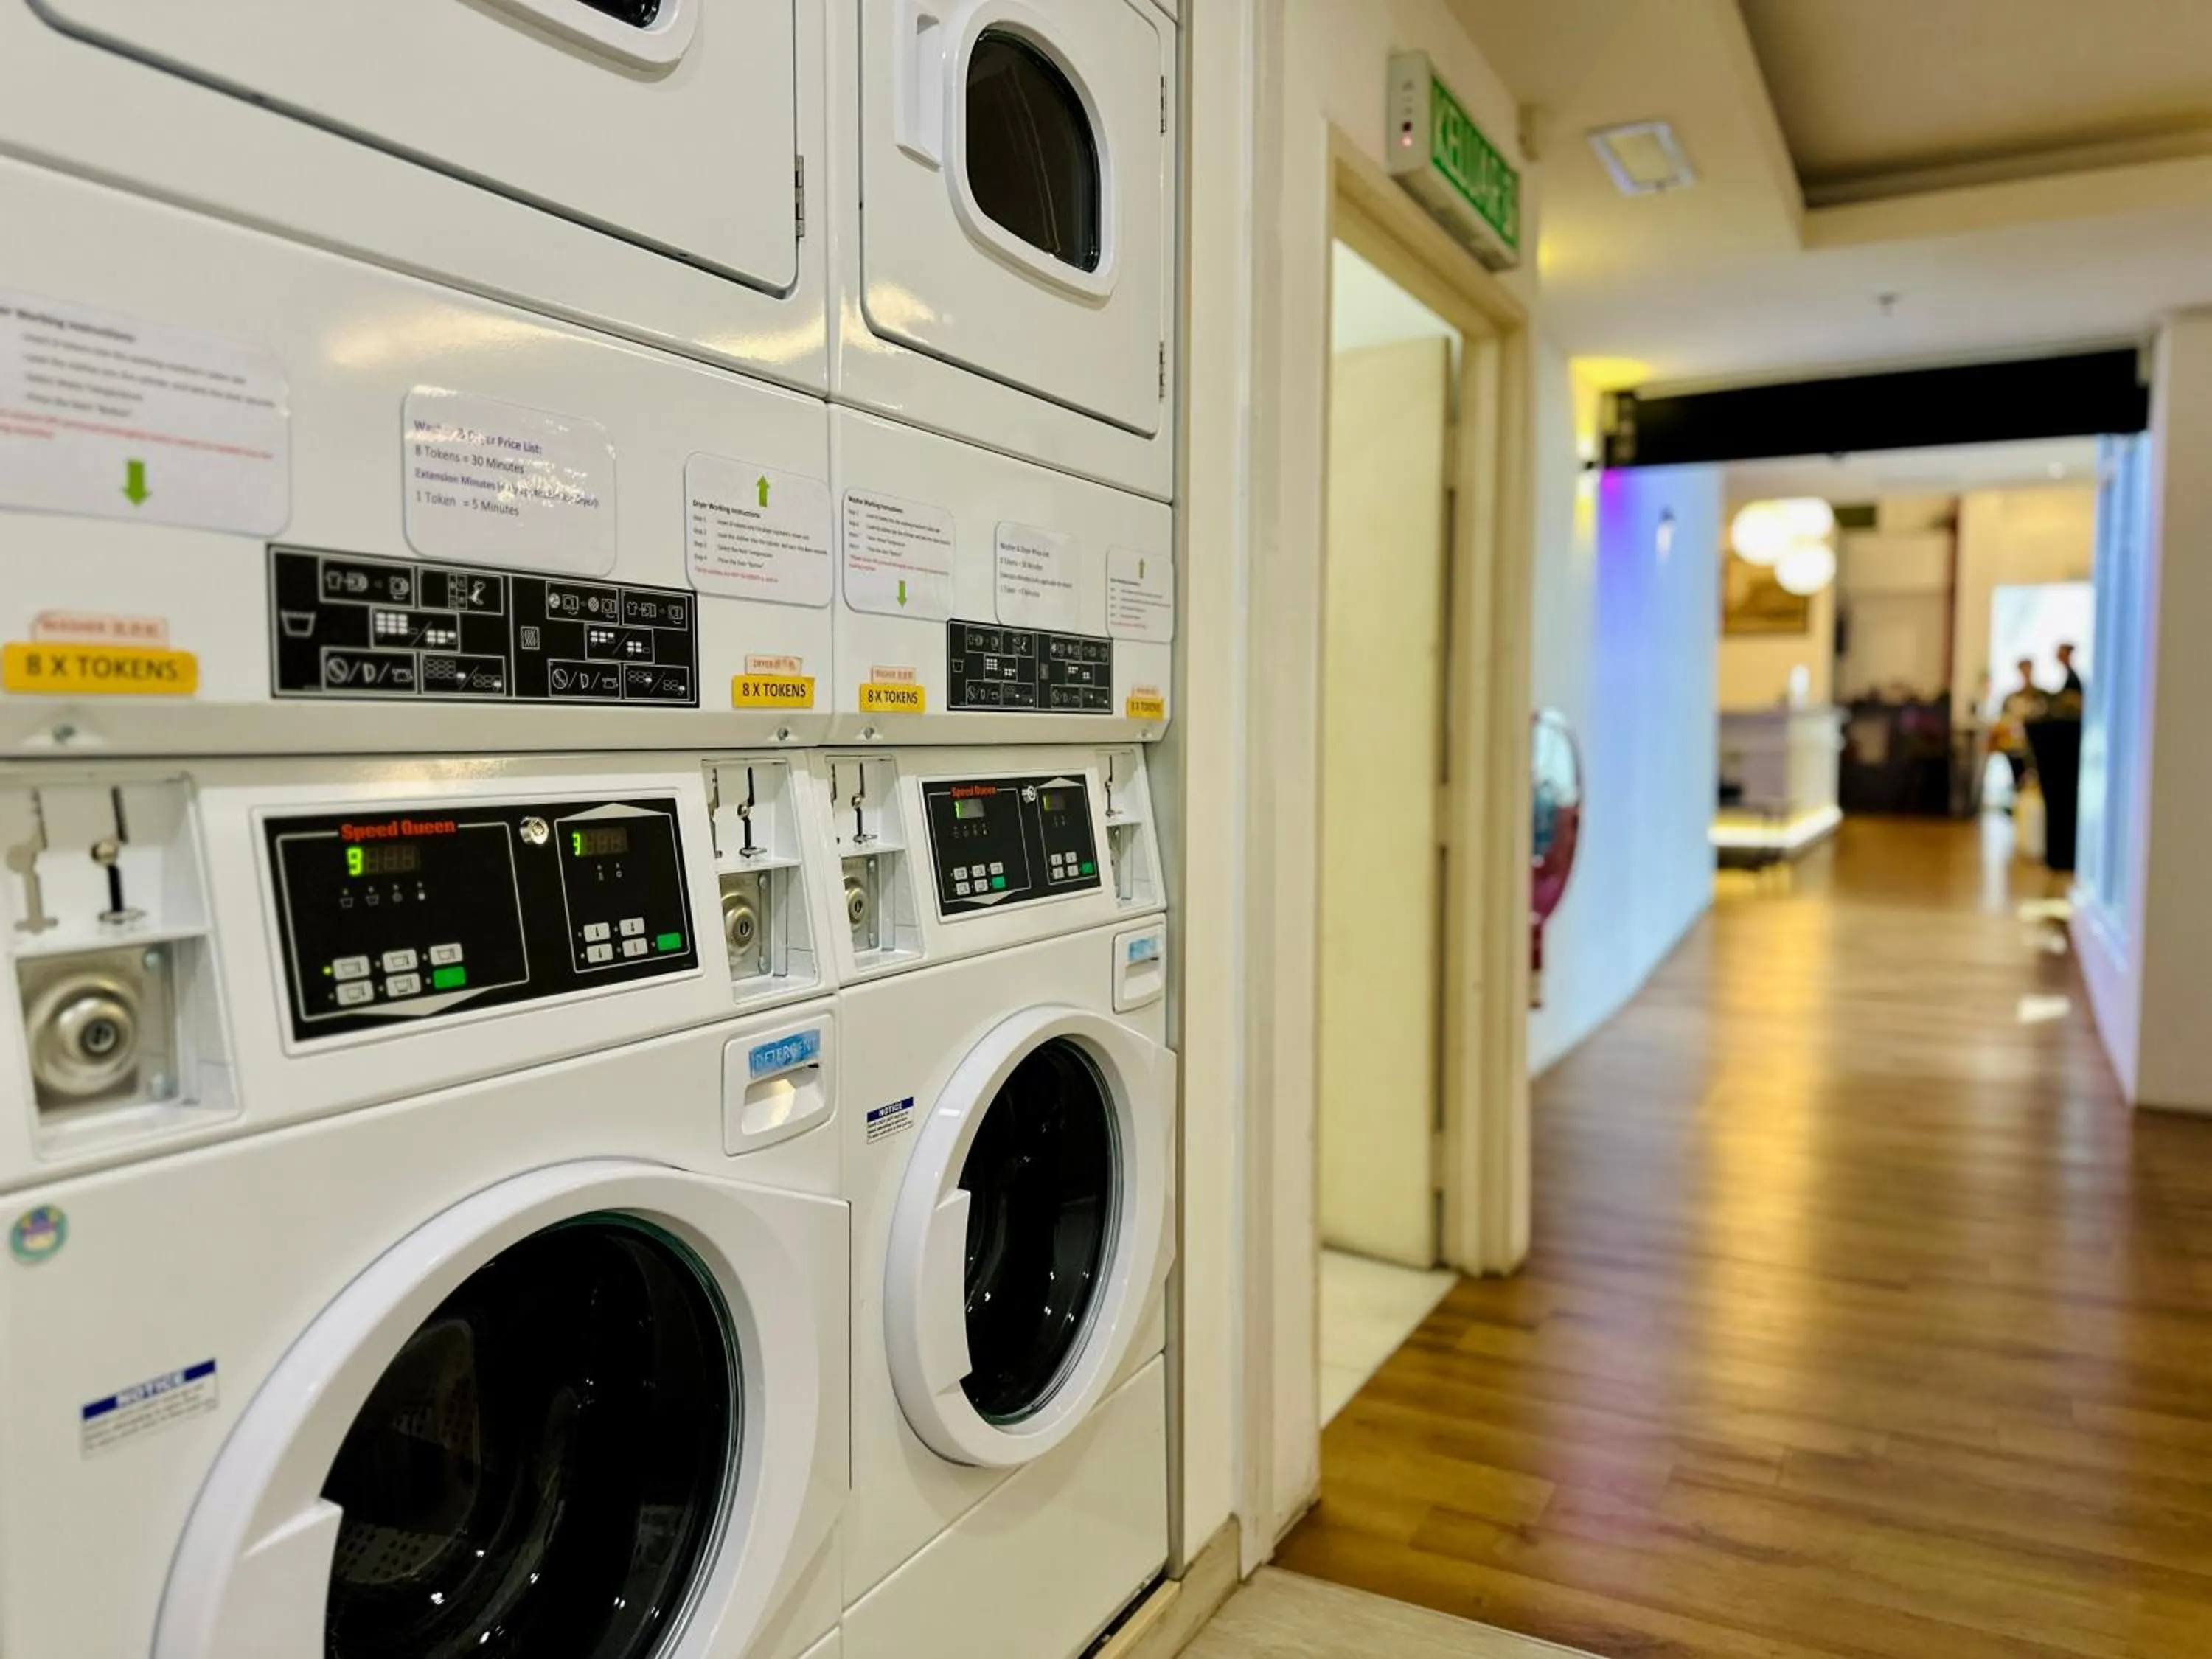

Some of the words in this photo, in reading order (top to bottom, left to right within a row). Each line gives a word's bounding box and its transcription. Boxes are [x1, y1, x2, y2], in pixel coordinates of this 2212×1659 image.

[498, 436, 521, 451] Price
[415, 444, 422, 457] 8
[425, 445, 460, 462] Tokens
[471, 453, 484, 466] 30
[486, 457, 524, 474] Minutes
[415, 467, 459, 483] Extension
[461, 476, 496, 490] Minutes
[417, 490, 422, 502] 1
[425, 491, 456, 507] Token
[472, 498, 479, 510] 5
[481, 501, 519, 517] Minutes
[50, 655, 68, 677] X
[76, 656, 178, 682] TOKENS
[742, 682, 750, 697] 8
[753, 683, 761, 697] X
[762, 683, 806, 698] TOKENS
[868, 689, 874, 703] 8
[875, 690, 882, 703] X
[883, 691, 918, 704] TOKENS
[341, 821, 399, 842] Speed
[401, 818, 456, 836] Queen
